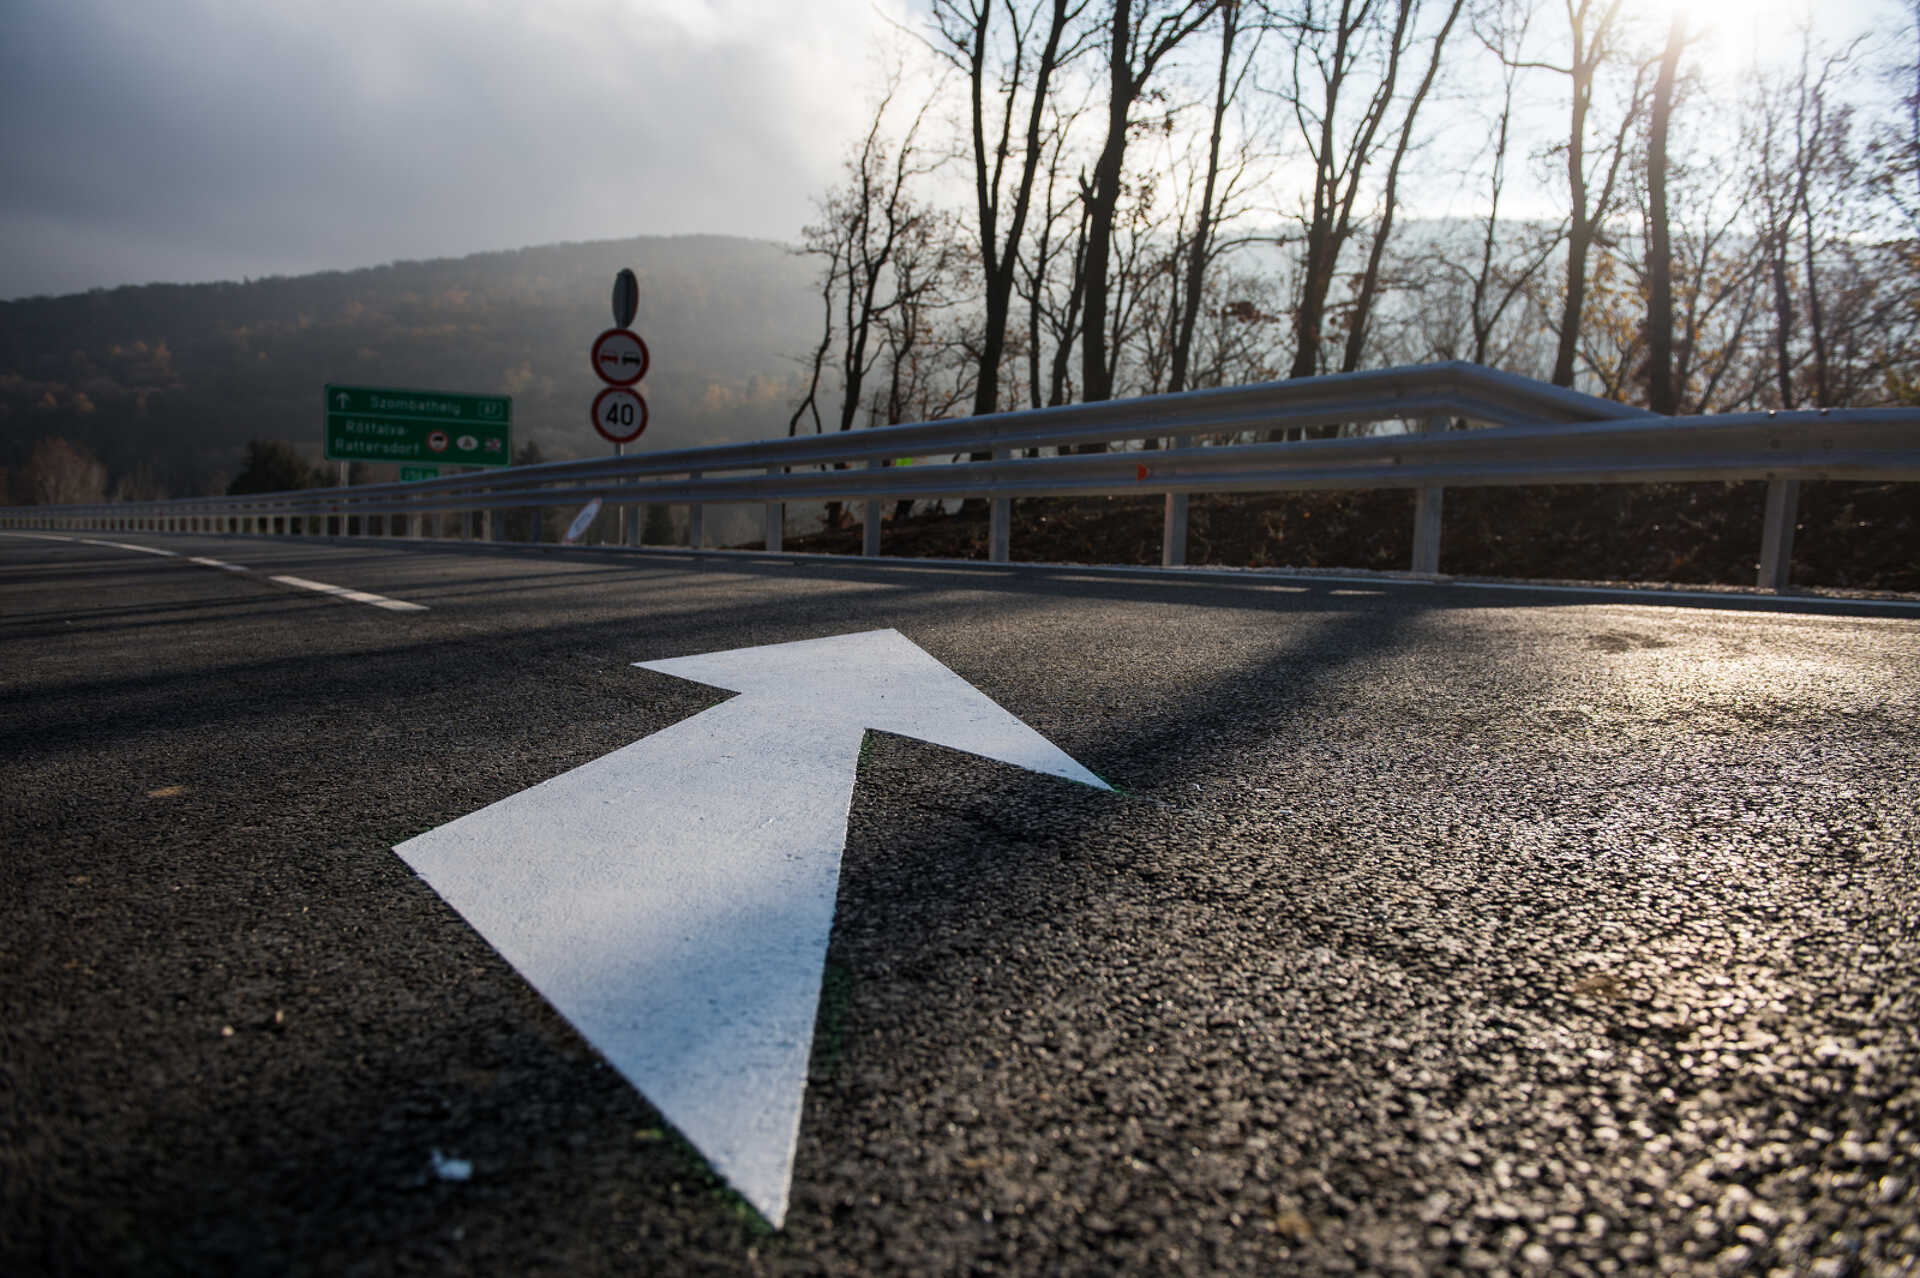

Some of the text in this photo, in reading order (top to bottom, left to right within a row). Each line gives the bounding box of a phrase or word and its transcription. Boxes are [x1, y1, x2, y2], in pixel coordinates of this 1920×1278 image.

[369, 394, 462, 417] Szombathely
[606, 403, 633, 426] 40
[335, 438, 420, 455] Rattersdorf
